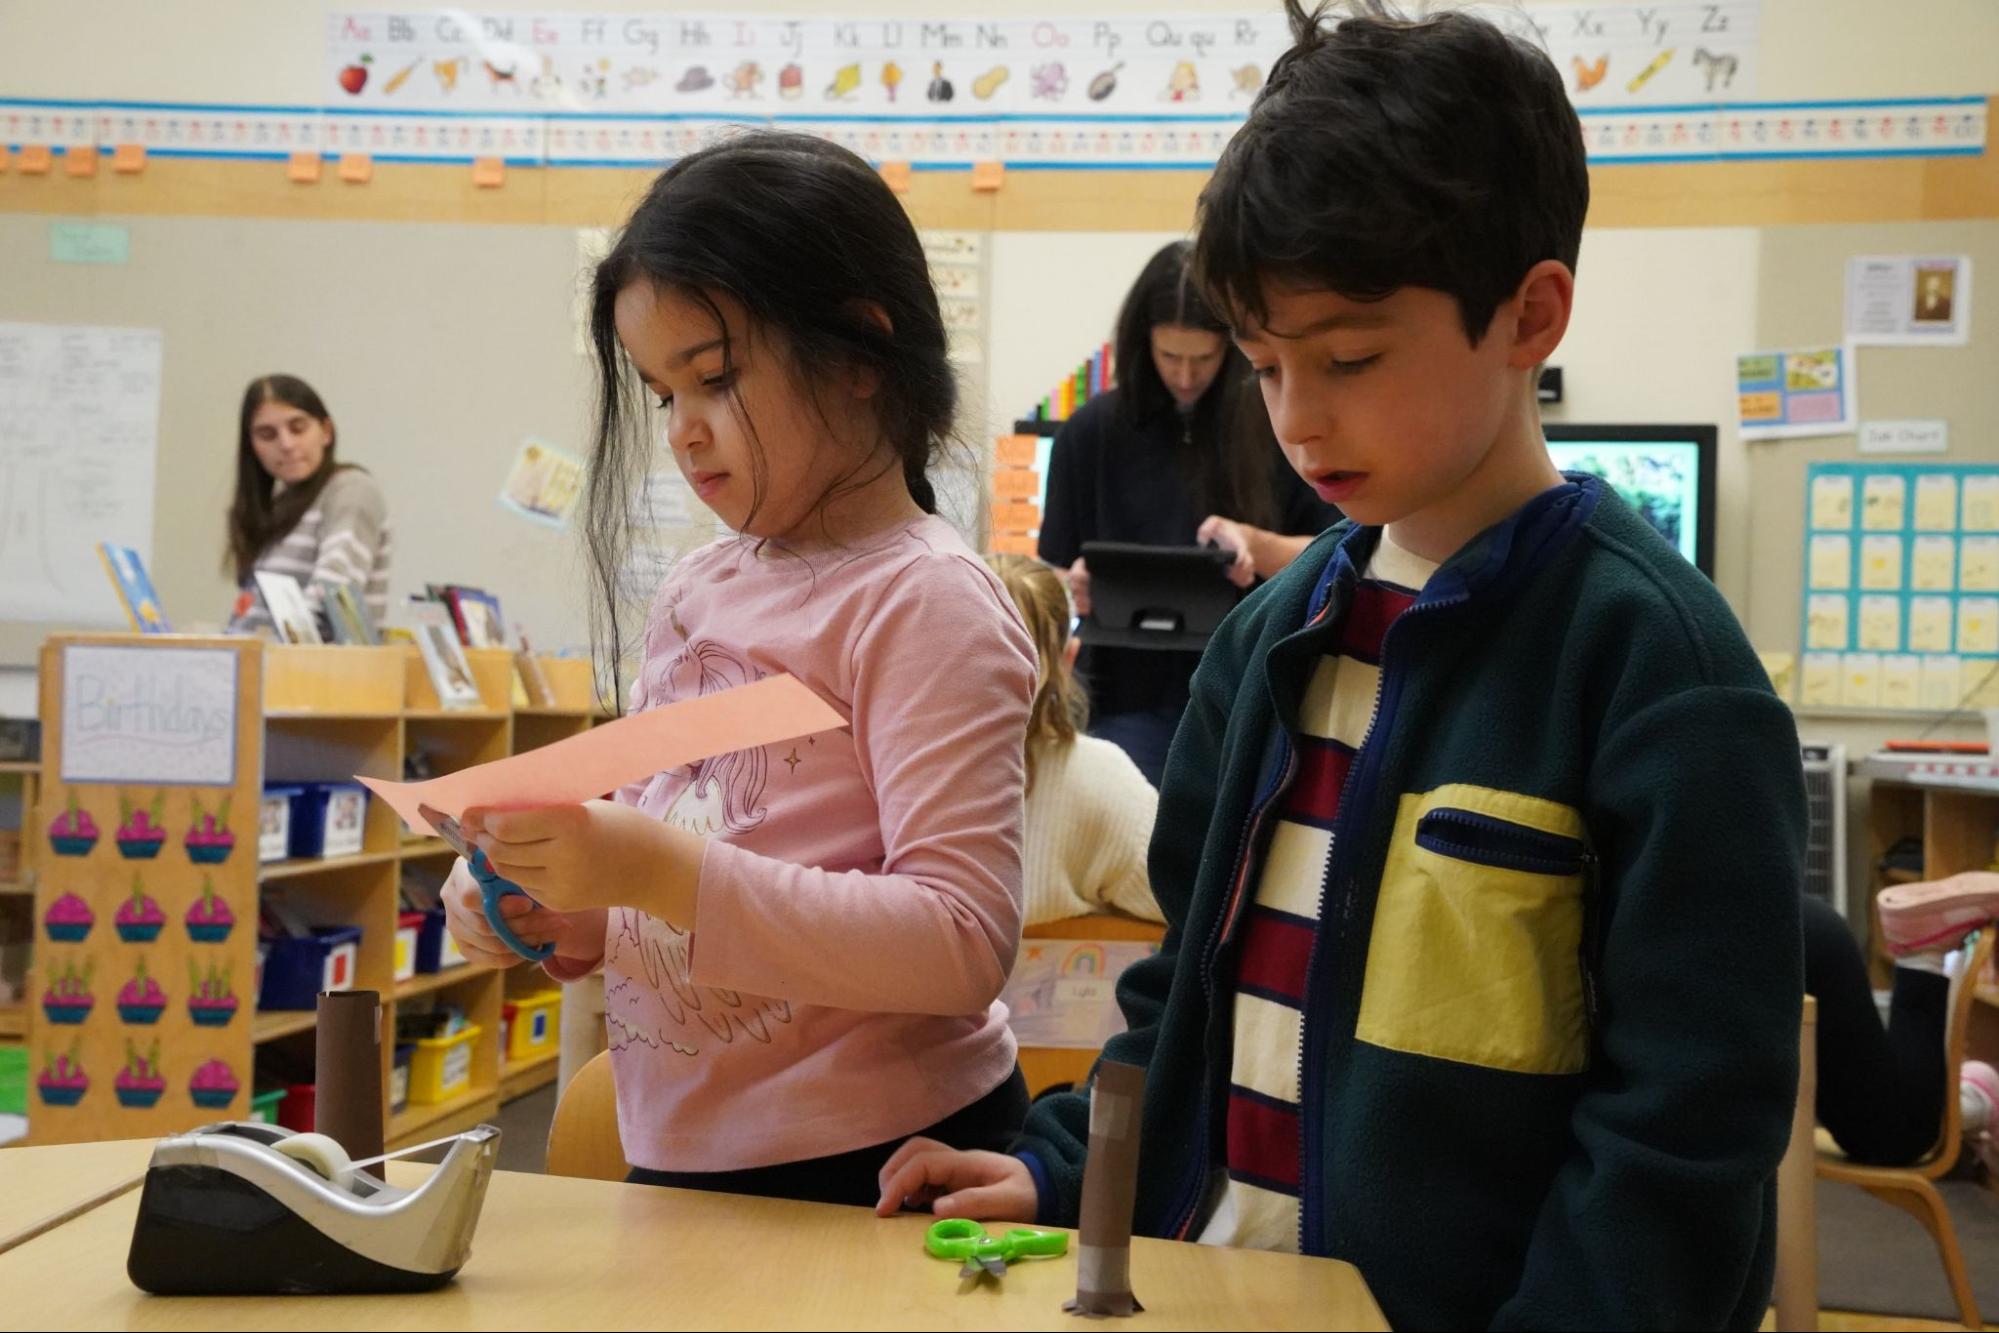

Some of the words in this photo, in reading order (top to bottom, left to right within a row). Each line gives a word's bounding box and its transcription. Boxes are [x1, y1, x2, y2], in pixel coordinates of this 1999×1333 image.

[343, 15, 371, 42] Aa
[388, 15, 416, 43] Bb
[434, 15, 464, 43] Cc
[532, 18, 559, 45] Ee
[581, 18, 607, 45] Ff
[622, 18, 659, 55] Gg
[680, 20, 711, 47] Hh
[732, 20, 755, 47] Ii
[781, 20, 804, 58] Jj
[834, 22, 859, 49] Kk
[920, 23, 963, 49] Mm
[976, 23, 1009, 49] Nn
[1031, 21, 1071, 48] Oo
[1093, 21, 1122, 58] Pp
[1146, 19, 1183, 48] Qu
[1190, 31, 1216, 58] qu
[1234, 19, 1261, 46] Rr
[1571, 9, 1605, 37] Xx
[1636, 7, 1670, 46] Yy
[1701, 4, 1729, 34] Zz
[75, 672, 229, 744] Birthdays
